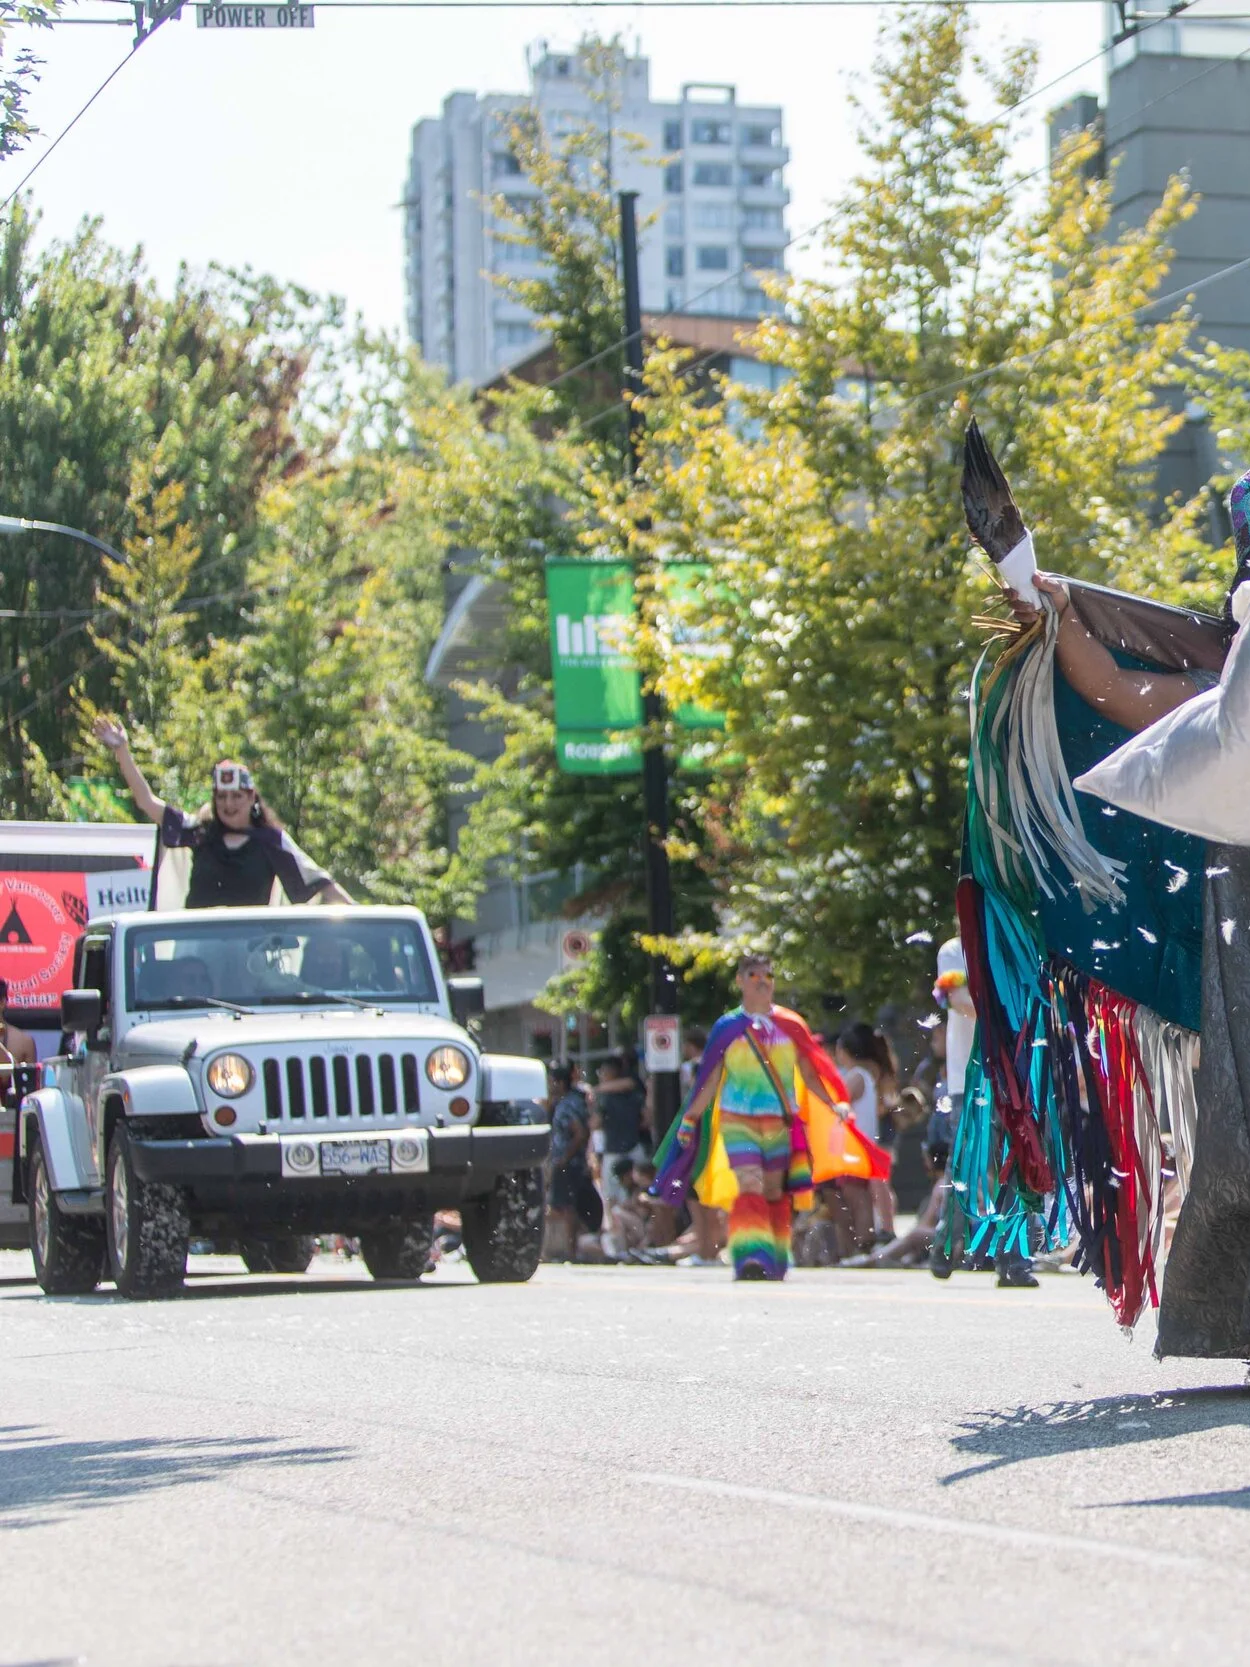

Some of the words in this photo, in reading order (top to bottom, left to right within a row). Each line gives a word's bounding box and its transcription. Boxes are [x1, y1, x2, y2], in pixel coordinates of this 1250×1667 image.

[203, 8, 265, 27] POWER
[277, 8, 308, 27] OFF
[98, 887, 149, 906] Heilt
